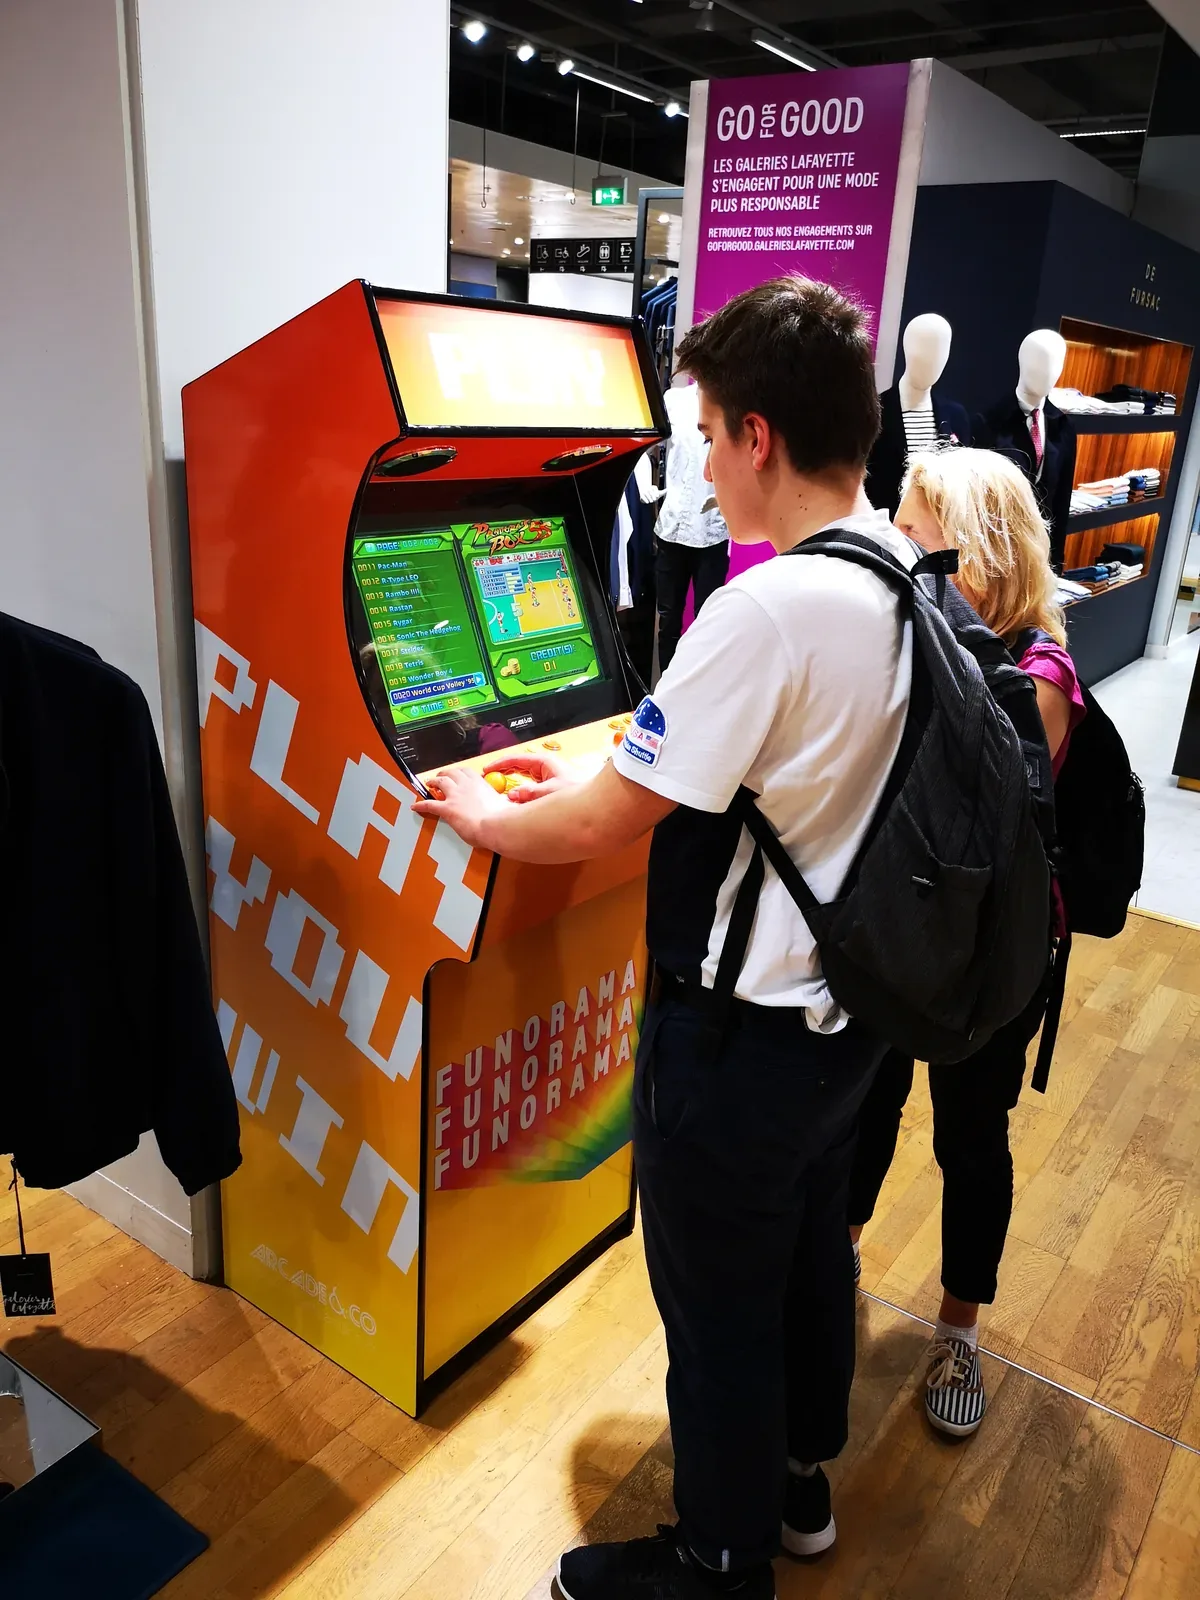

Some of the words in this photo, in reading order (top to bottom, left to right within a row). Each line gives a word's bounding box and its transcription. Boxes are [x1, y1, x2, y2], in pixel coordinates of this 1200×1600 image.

[716, 104, 756, 142] GO
[759, 103, 776, 139] FOR
[780, 97, 865, 138] GOOD
[713, 157, 733, 174] LES
[735, 155, 788, 172] GALERIES
[791, 152, 855, 169] LAFAYETTE
[712, 176, 780, 194] S'ENGAGENT
[782, 175, 814, 191] POUR
[817, 174, 841, 190] UNE
[844, 172, 880, 188] MODE
[710, 197, 738, 213] PLUS
[741, 195, 820, 212] RESPONSABLE
[708, 227, 752, 238] RETROUVEZ
[754, 226, 774, 237] TOUS
[775, 226, 792, 237] NOS
[793, 224, 854, 237] ENGAGEMENTS
[855, 224, 873, 236] SUR
[707, 239, 855, 252] GOFORGOOD.GALERIESLAFAYETTE.COM
[1145, 263, 1156, 282] DE
[1130, 287, 1161, 311] FURSAC
[377, 561, 408, 570] Pac-Man
[381, 576, 405, 585] R-Type
[405, 573, 419, 581] LEO
[385, 589, 410, 598] Rambo
[389, 604, 413, 613] Rastan
[393, 618, 413, 628] Rygar
[396, 631, 415, 641] Sonic
[415, 629, 428, 638] The
[429, 624, 461, 636] Hedgehog
[404, 660, 424, 669] Tetris
[407, 671, 434, 683] Wonder
[435, 669, 447, 679] Boy
[411, 686, 432, 696] World
[432, 682, 446, 693] Cup
[446, 679, 466, 690] Volley
[194, 618, 484, 953] PLAY
[205, 814, 423, 1083] YOU
[436, 959, 636, 1108] FUNORAMA
[435, 996, 633, 1150] FUNORAMA
[434, 1032, 631, 1191] FUNORAMA
